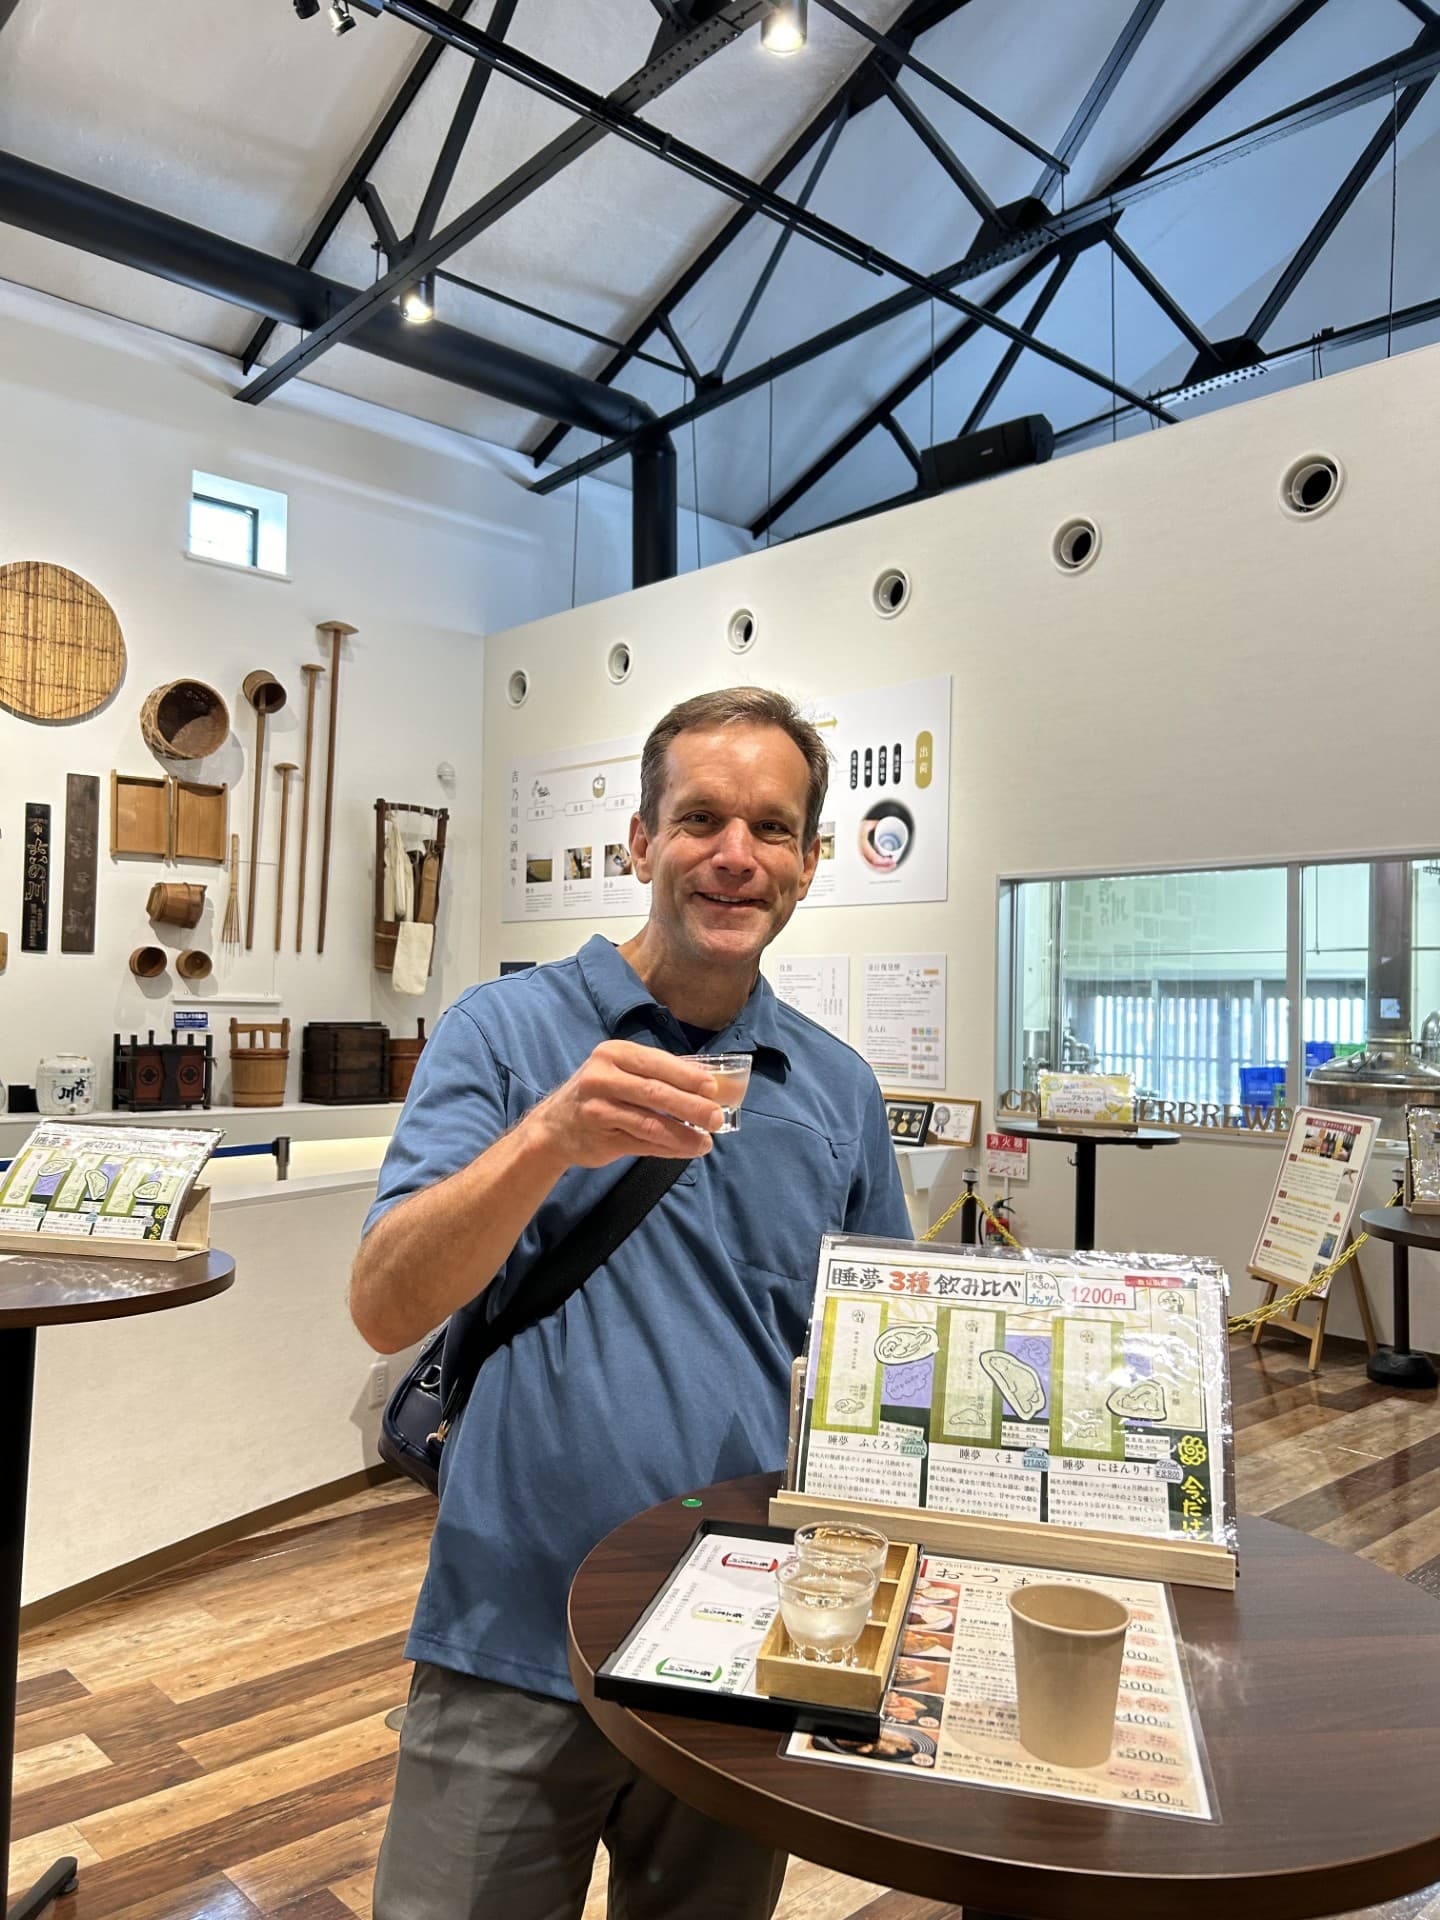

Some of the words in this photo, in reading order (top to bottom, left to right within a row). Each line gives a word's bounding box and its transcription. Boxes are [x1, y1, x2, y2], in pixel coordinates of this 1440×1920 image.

[1000, 1089, 1038, 1112] CR
[831, 1267, 884, 1290] 睡夢
[888, 1270, 933, 1295] 3種
[934, 1273, 1022, 1298] 飲み比べ
[1071, 1286, 1127, 1305] 1200円
[859, 1438, 899, 1451] ふくろう
[994, 1451, 1014, 1464] くま
[1097, 1460, 1154, 1475] にほんりす
